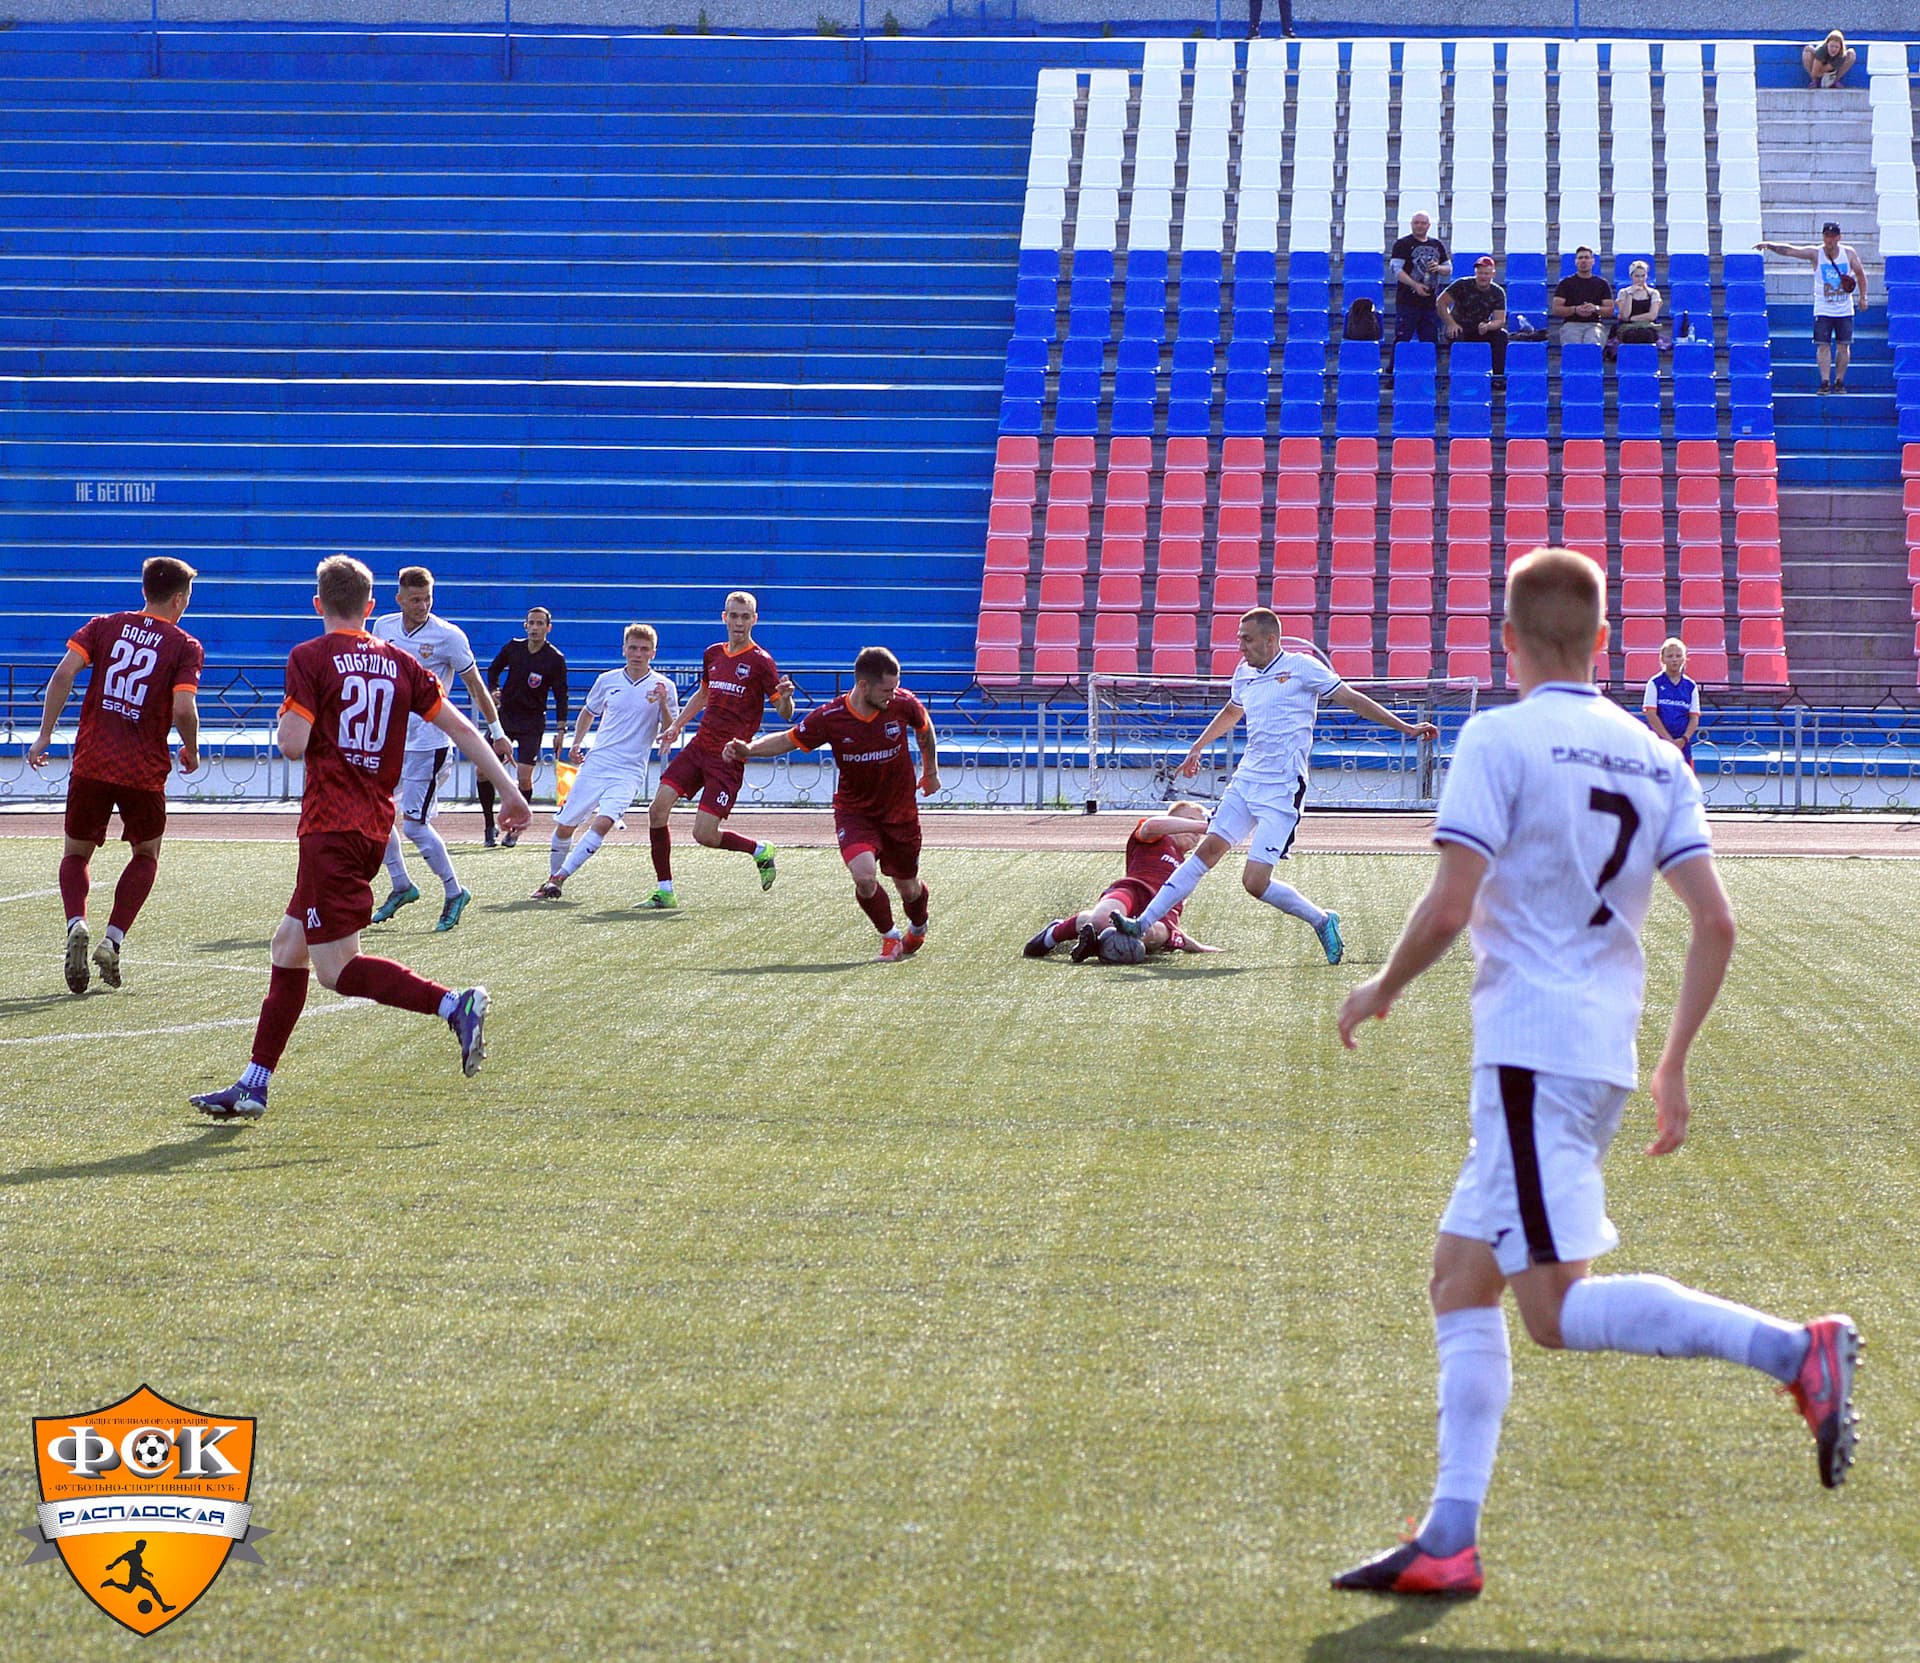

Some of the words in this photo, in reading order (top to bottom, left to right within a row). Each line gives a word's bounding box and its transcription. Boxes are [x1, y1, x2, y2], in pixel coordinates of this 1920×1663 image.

[76, 482, 94, 502] НЕ
[97, 482, 156, 502] БЕГАТЬ!
[121, 624, 163, 648] БАБИЧ
[103, 639, 158, 707] 22
[332, 653, 398, 679] БОБЕШХО
[338, 675, 395, 753] 20
[716, 791, 730, 807] 33
[1588, 786, 1641, 927] 7
[307, 907, 322, 929] 20
